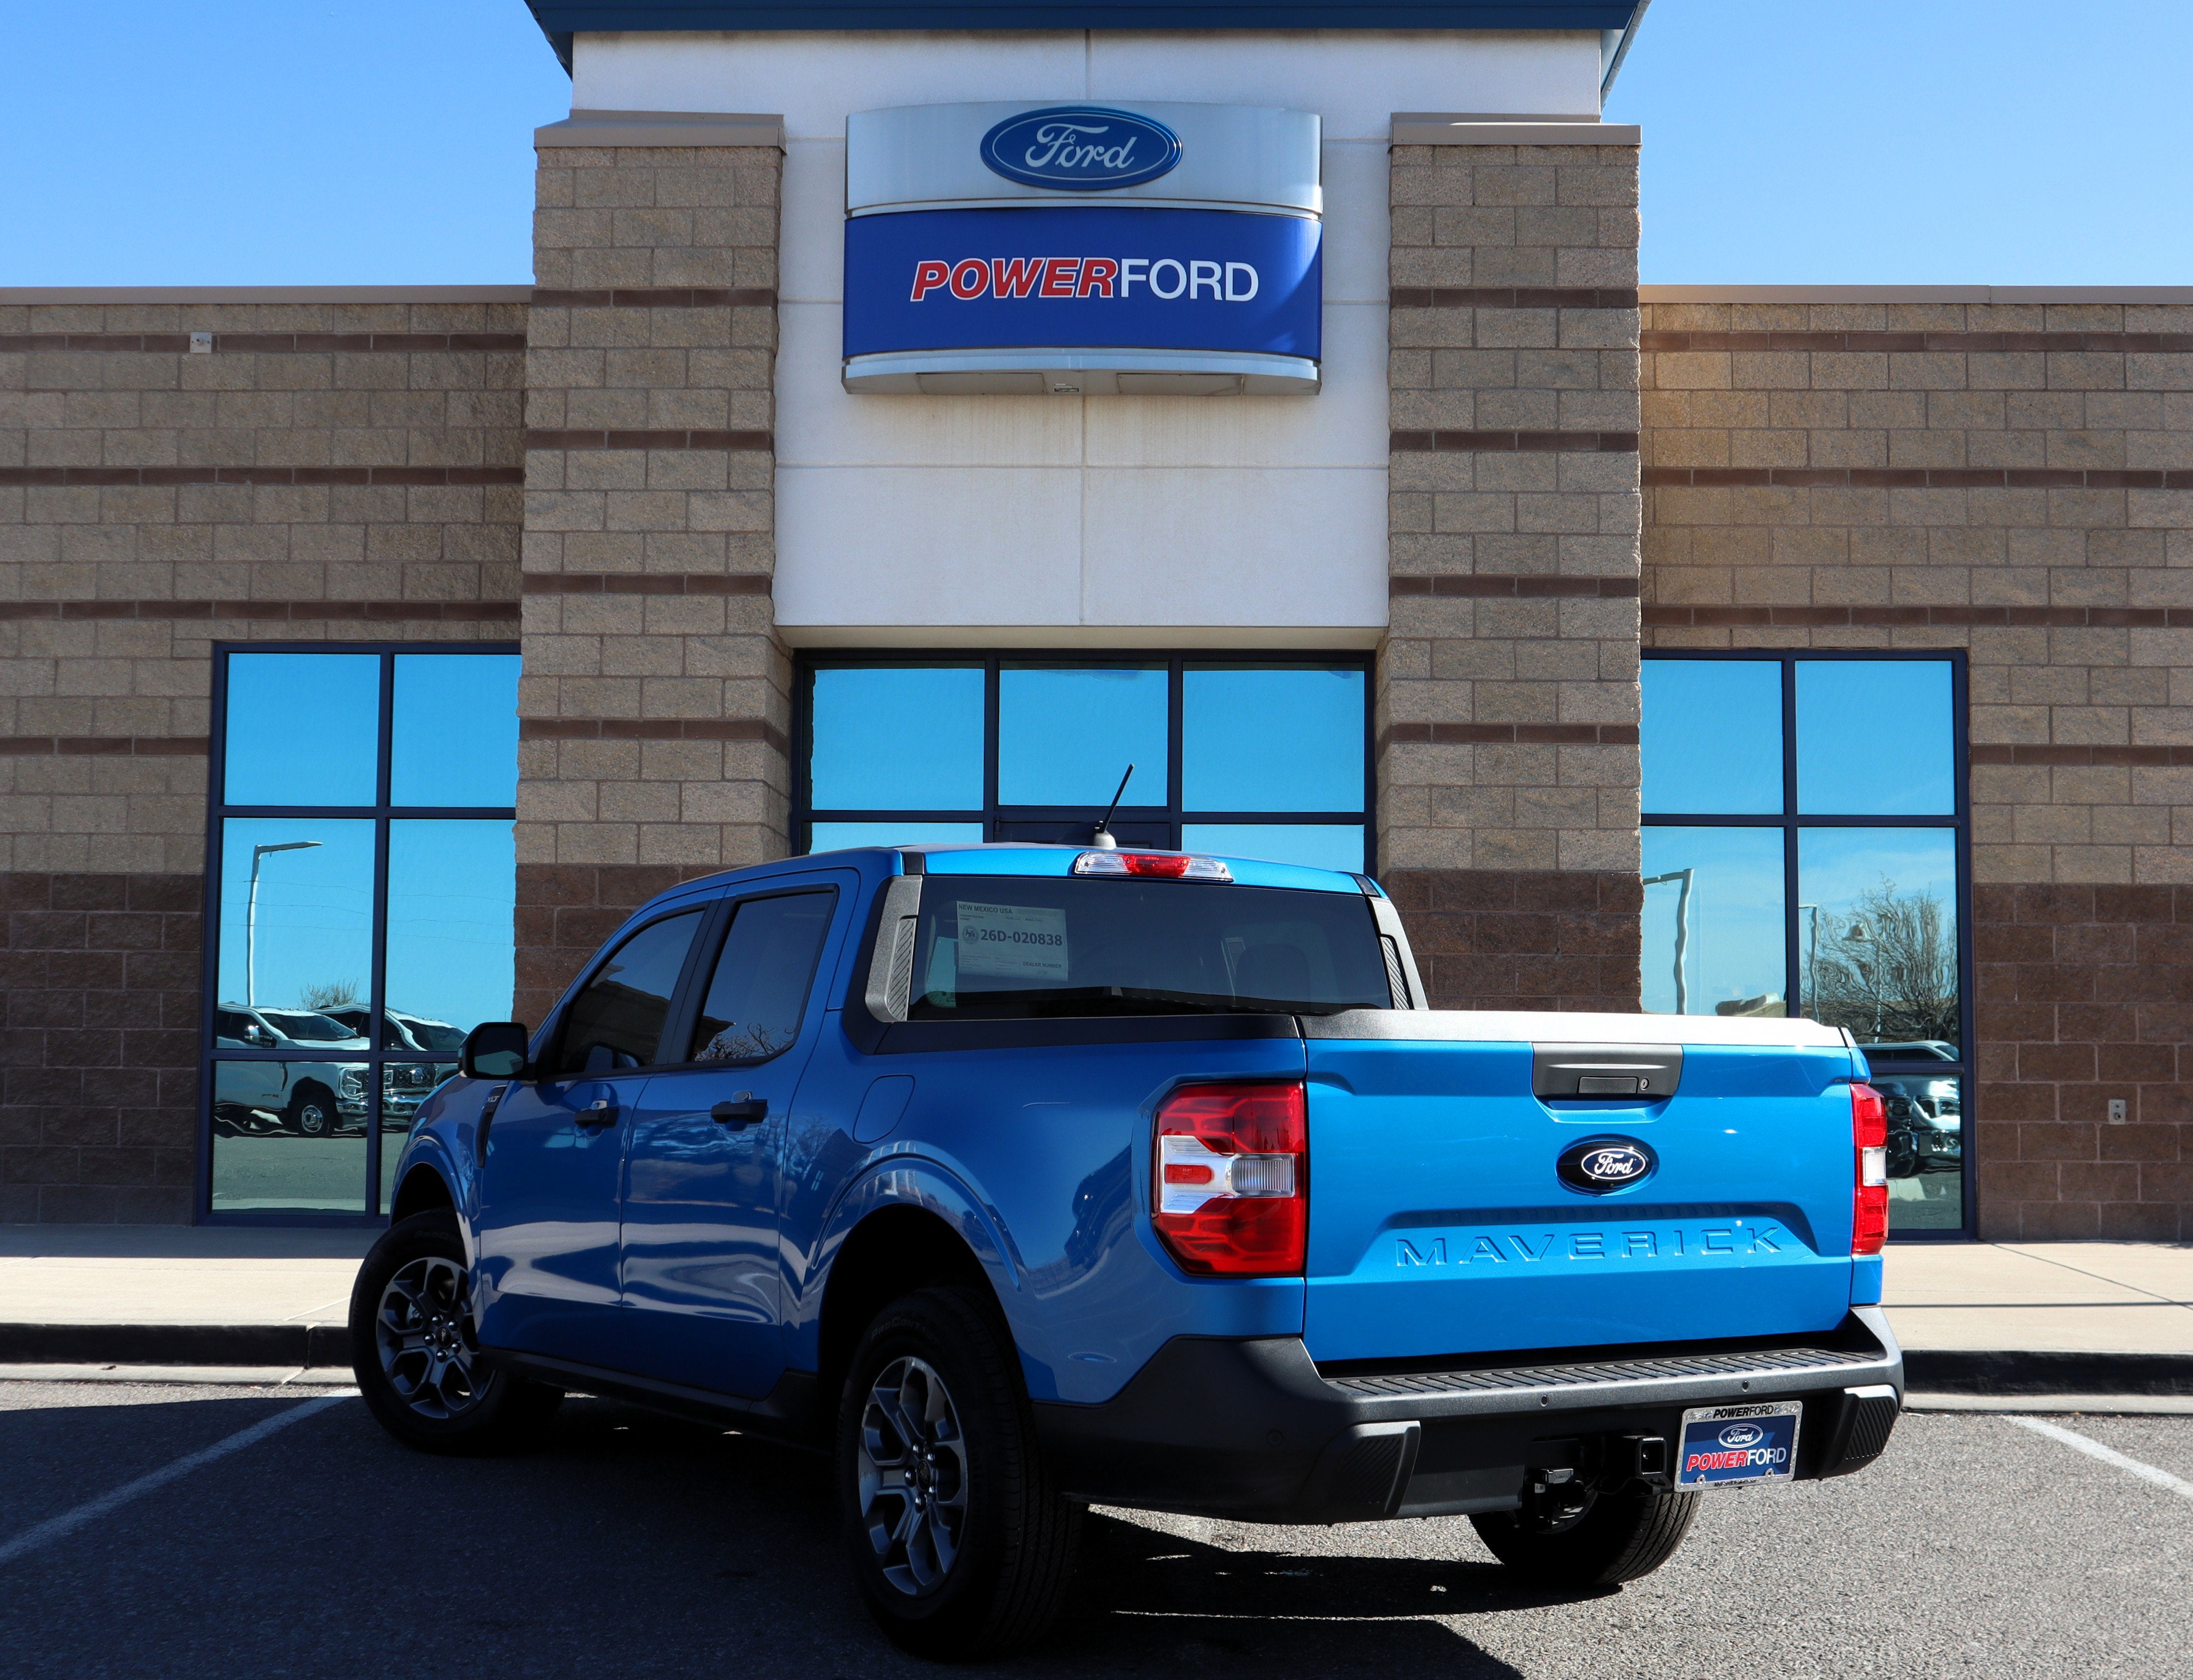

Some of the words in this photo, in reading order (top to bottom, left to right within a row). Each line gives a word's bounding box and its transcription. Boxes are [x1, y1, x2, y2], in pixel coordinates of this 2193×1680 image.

[1025, 123, 1137, 169] Ford
[910, 257, 1259, 302] POWERFORD
[980, 929, 1063, 946] 26D-020838
[1594, 1152, 1634, 1175] Ford
[1397, 1228, 1782, 1267] MAVERICK
[1713, 1405, 1774, 1419] POWERFORD
[1727, 1428, 1754, 1443] Ford
[1686, 1447, 1787, 1472] POWERFORD
